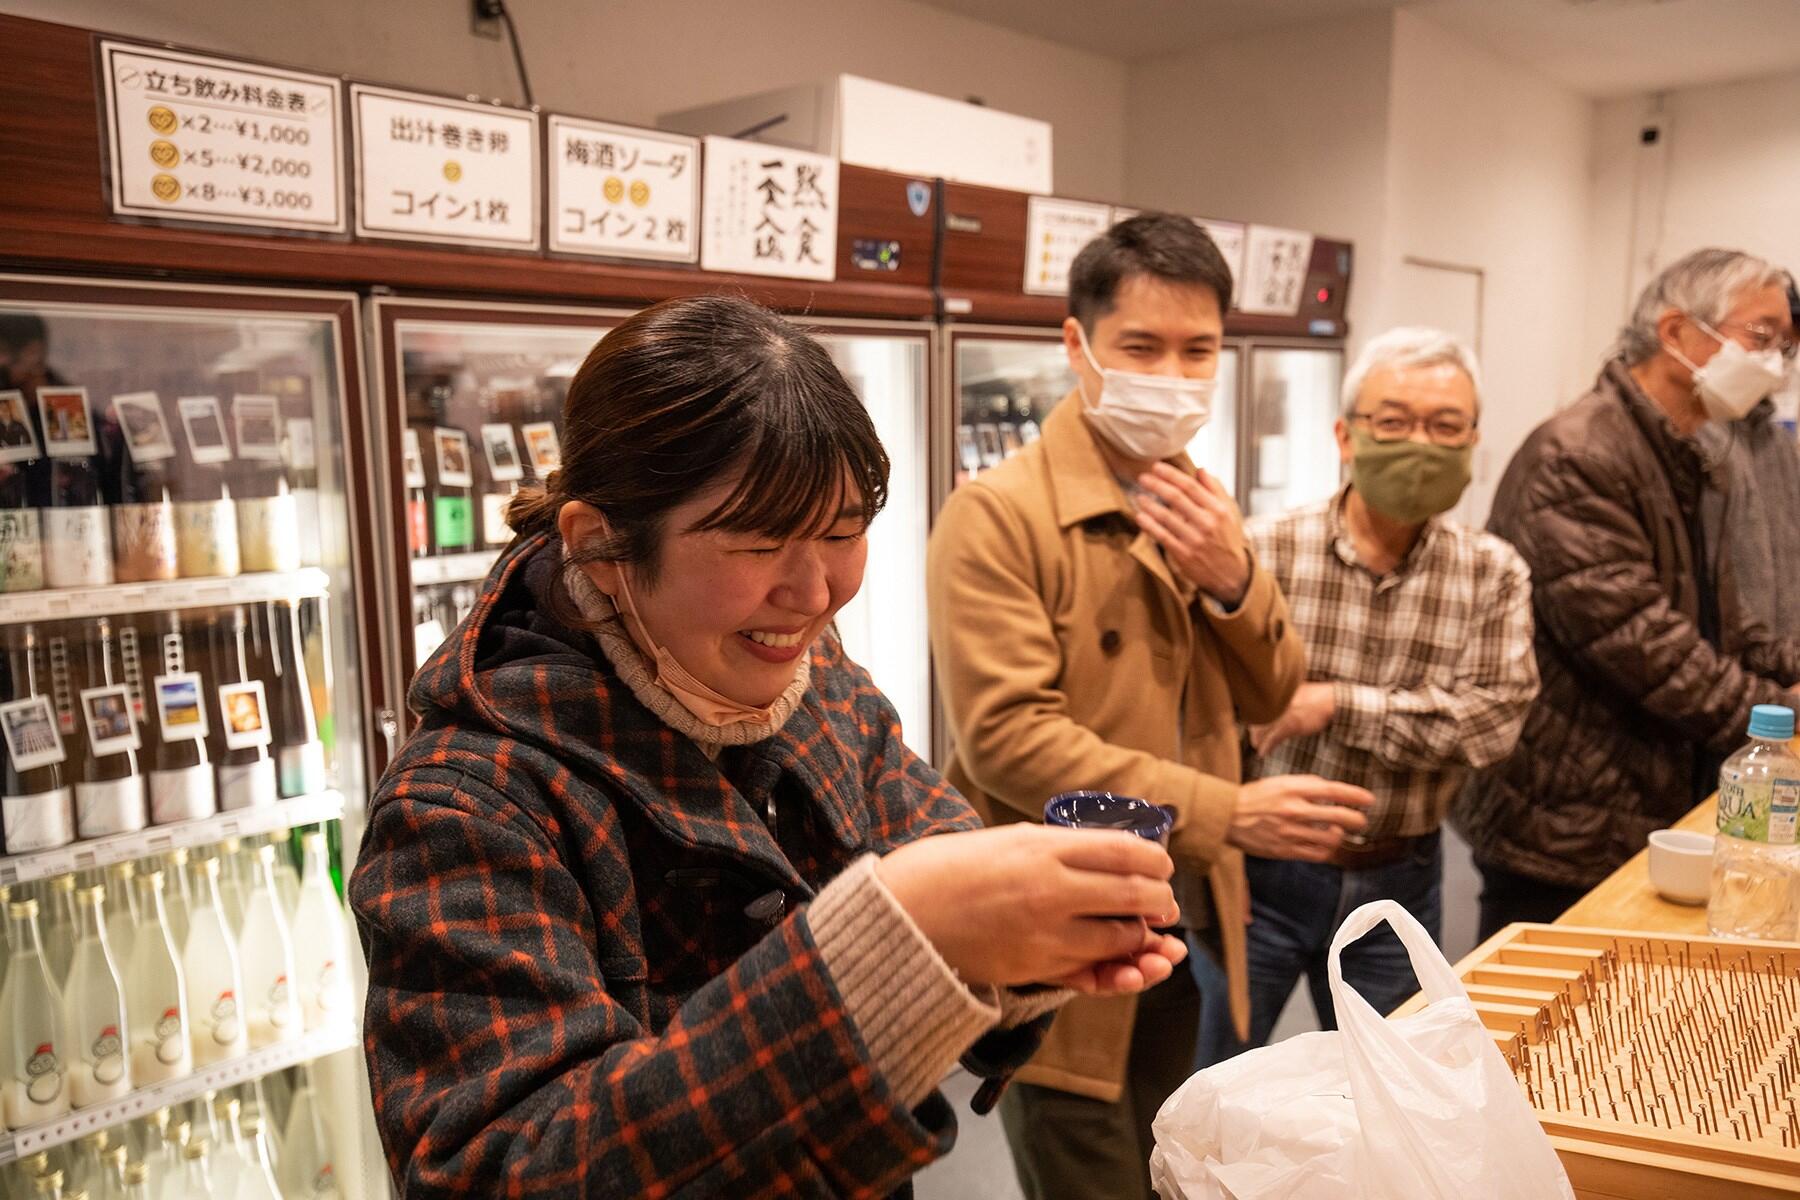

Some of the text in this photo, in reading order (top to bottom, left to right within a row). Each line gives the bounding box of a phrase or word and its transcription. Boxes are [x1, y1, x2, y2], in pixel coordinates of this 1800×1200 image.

[144, 70, 307, 113] 立ち飲み料金表
[390, 116, 510, 154] 出汁巻き卵
[566, 136, 687, 179] 梅酒ソーダ
[391, 189, 510, 225] コイン1枚
